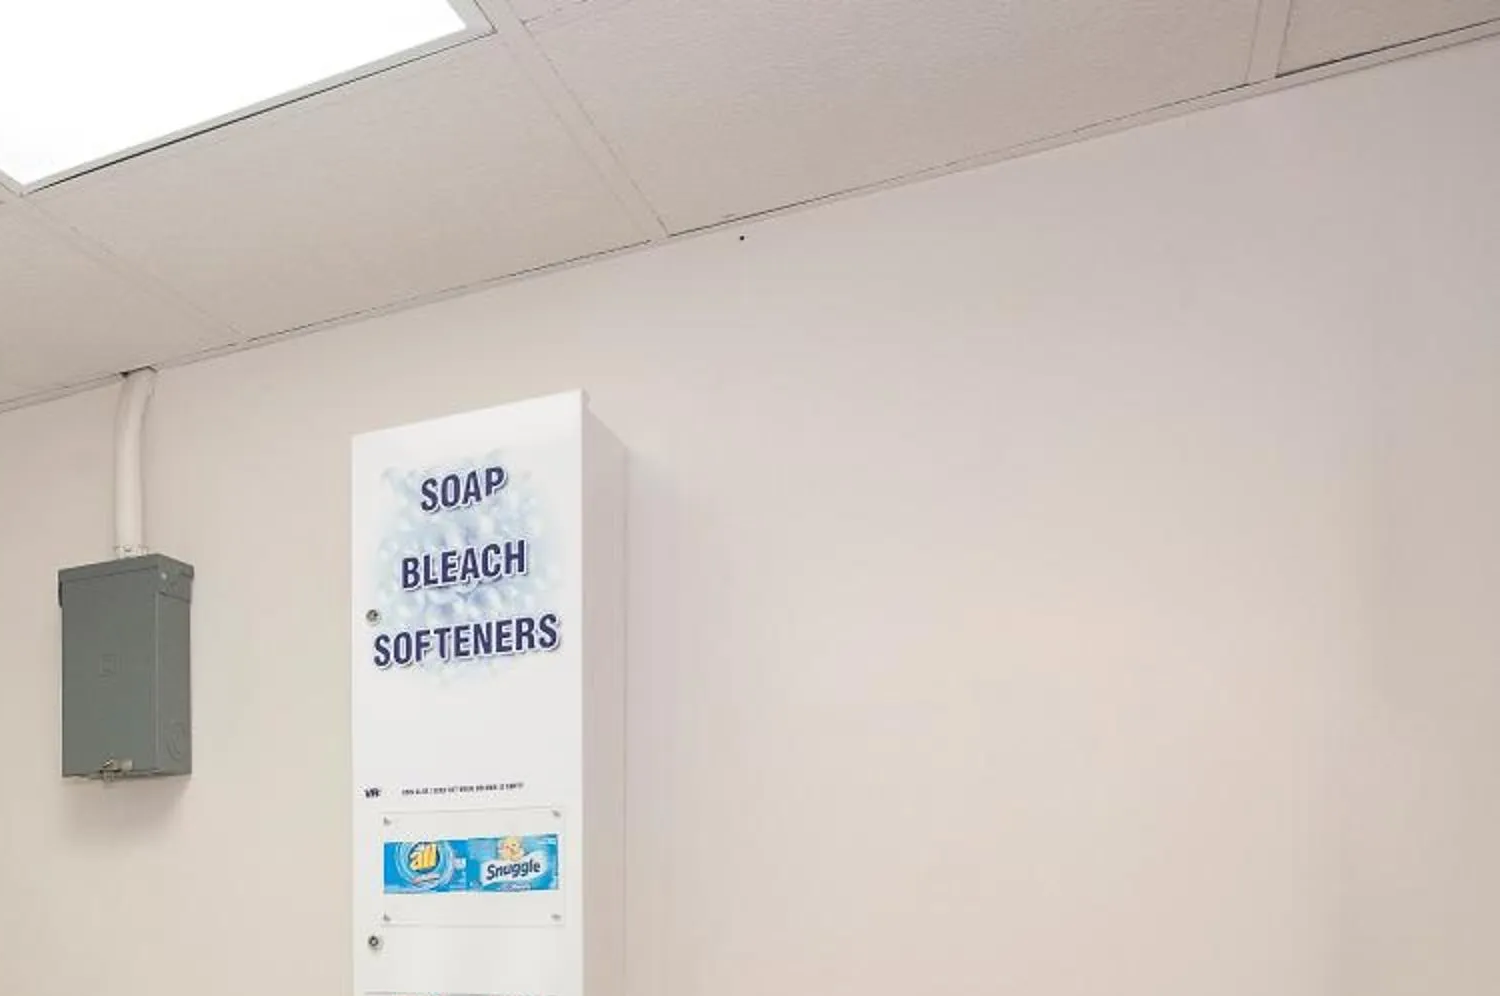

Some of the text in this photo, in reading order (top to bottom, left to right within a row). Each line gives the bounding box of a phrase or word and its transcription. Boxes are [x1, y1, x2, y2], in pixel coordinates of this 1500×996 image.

[420, 466, 506, 512] SOAP
[402, 539, 527, 590] BLEACH
[373, 613, 560, 668] SOFTENERS
[408, 842, 437, 871] all
[486, 858, 541, 881] Snuggle
